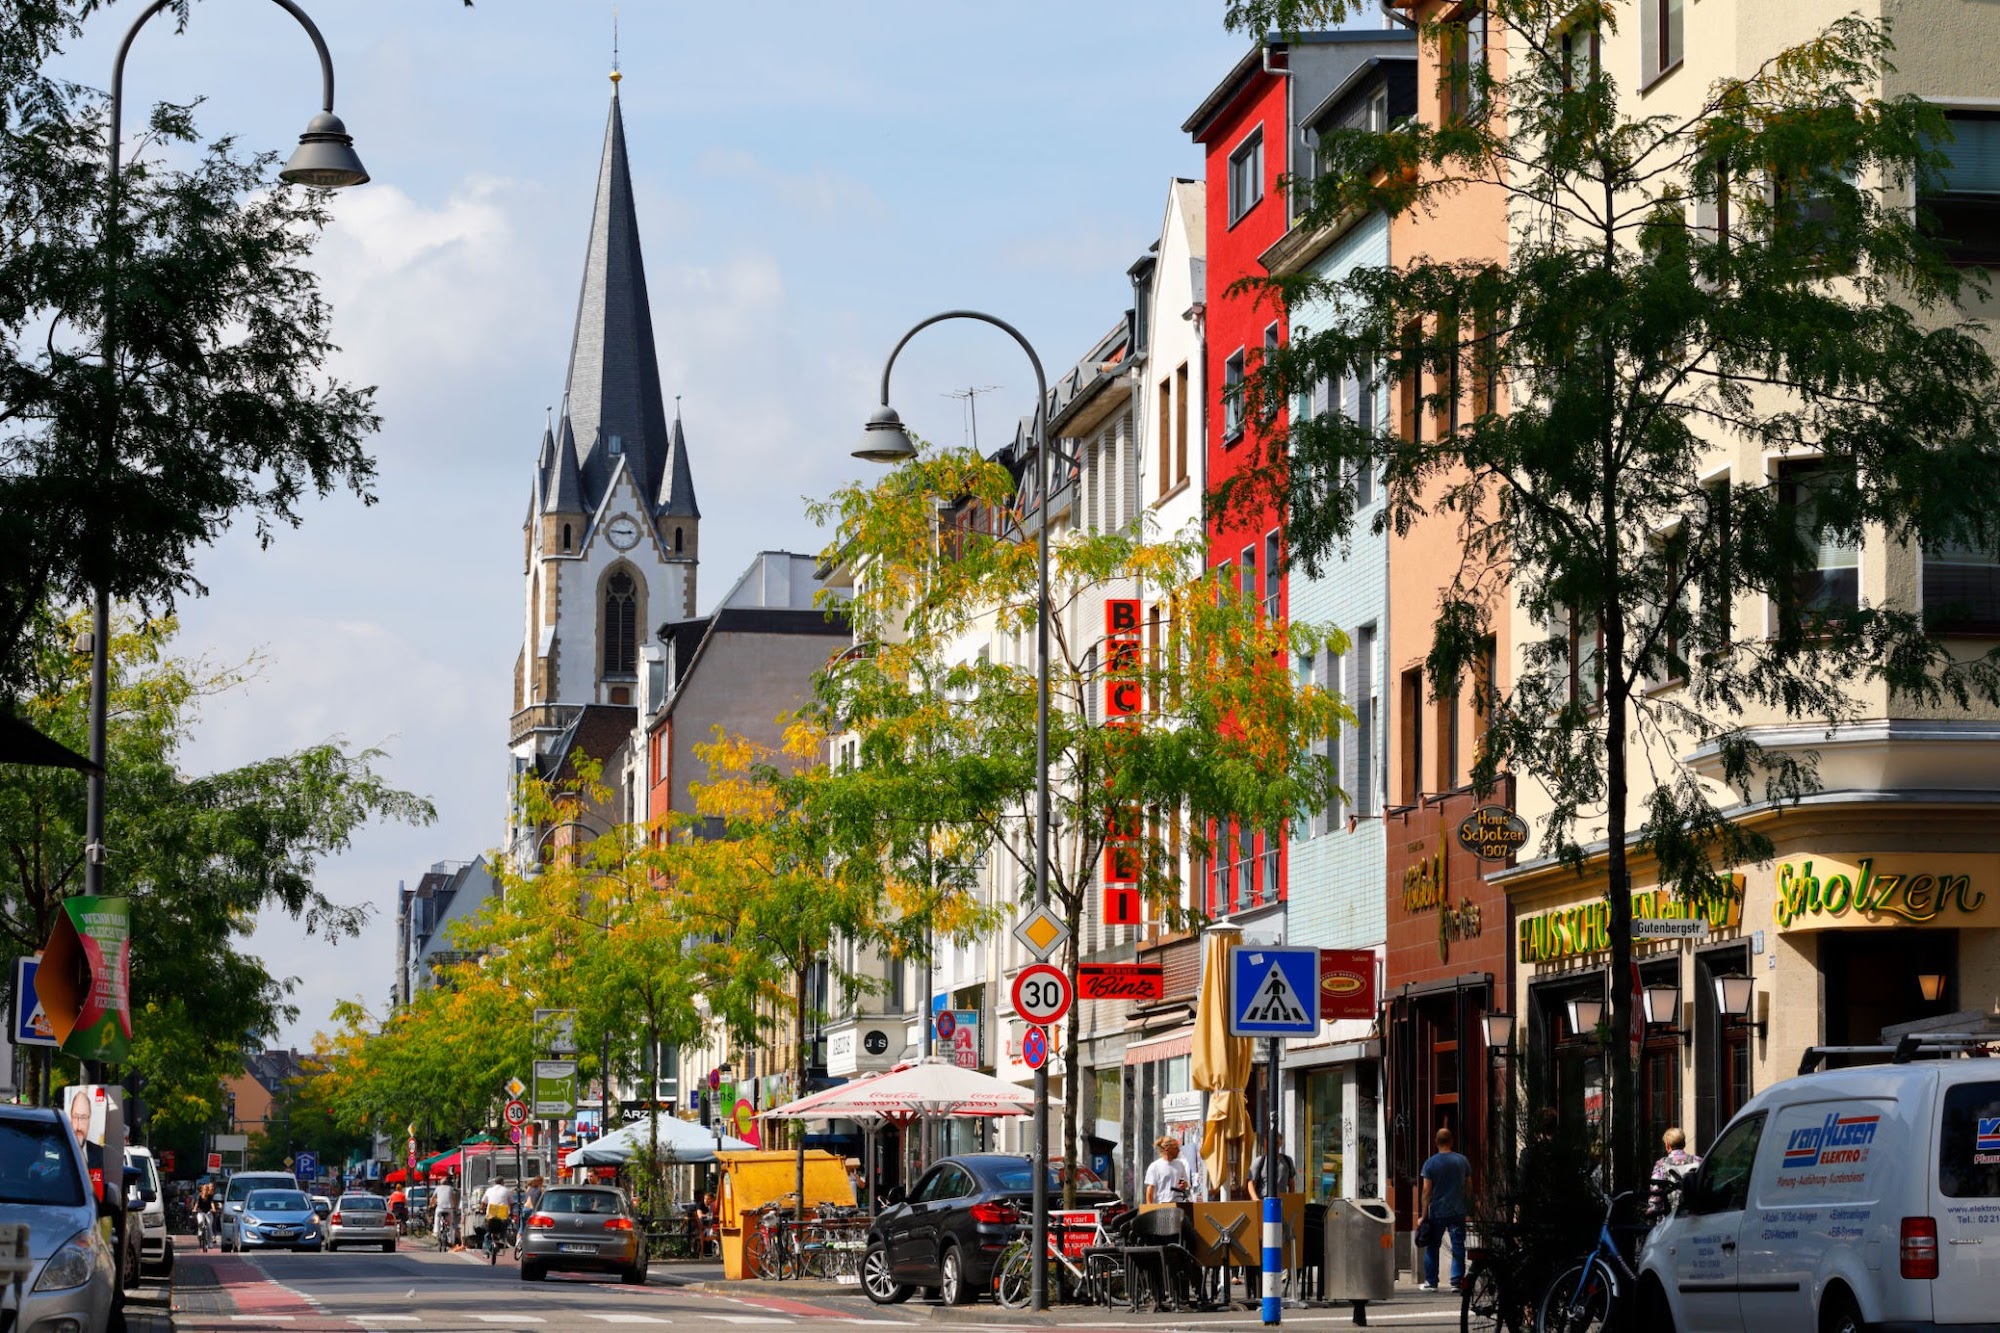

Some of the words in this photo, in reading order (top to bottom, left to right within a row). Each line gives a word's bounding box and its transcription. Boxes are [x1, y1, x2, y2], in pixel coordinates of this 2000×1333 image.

[1477, 810, 1510, 825] Haus
[1461, 824, 1526, 842] Scholzen
[1482, 844, 1508, 857] 1907
[1772, 857, 1985, 928] Scholzen
[1520, 909, 1563, 964] HAUS
[1563, 890, 1658, 957] SCHOEN
[1637, 921, 1704, 937] Gutenbergstr.
[1104, 968, 1140, 976] WERNER
[1087, 975, 1157, 998] Binz
[1024, 981, 1059, 1009] 30
[509, 1107, 523, 1120] 30
[1095, 1156, 1104, 1170] P
[1819, 1149, 1861, 1165] ELEKTRO
